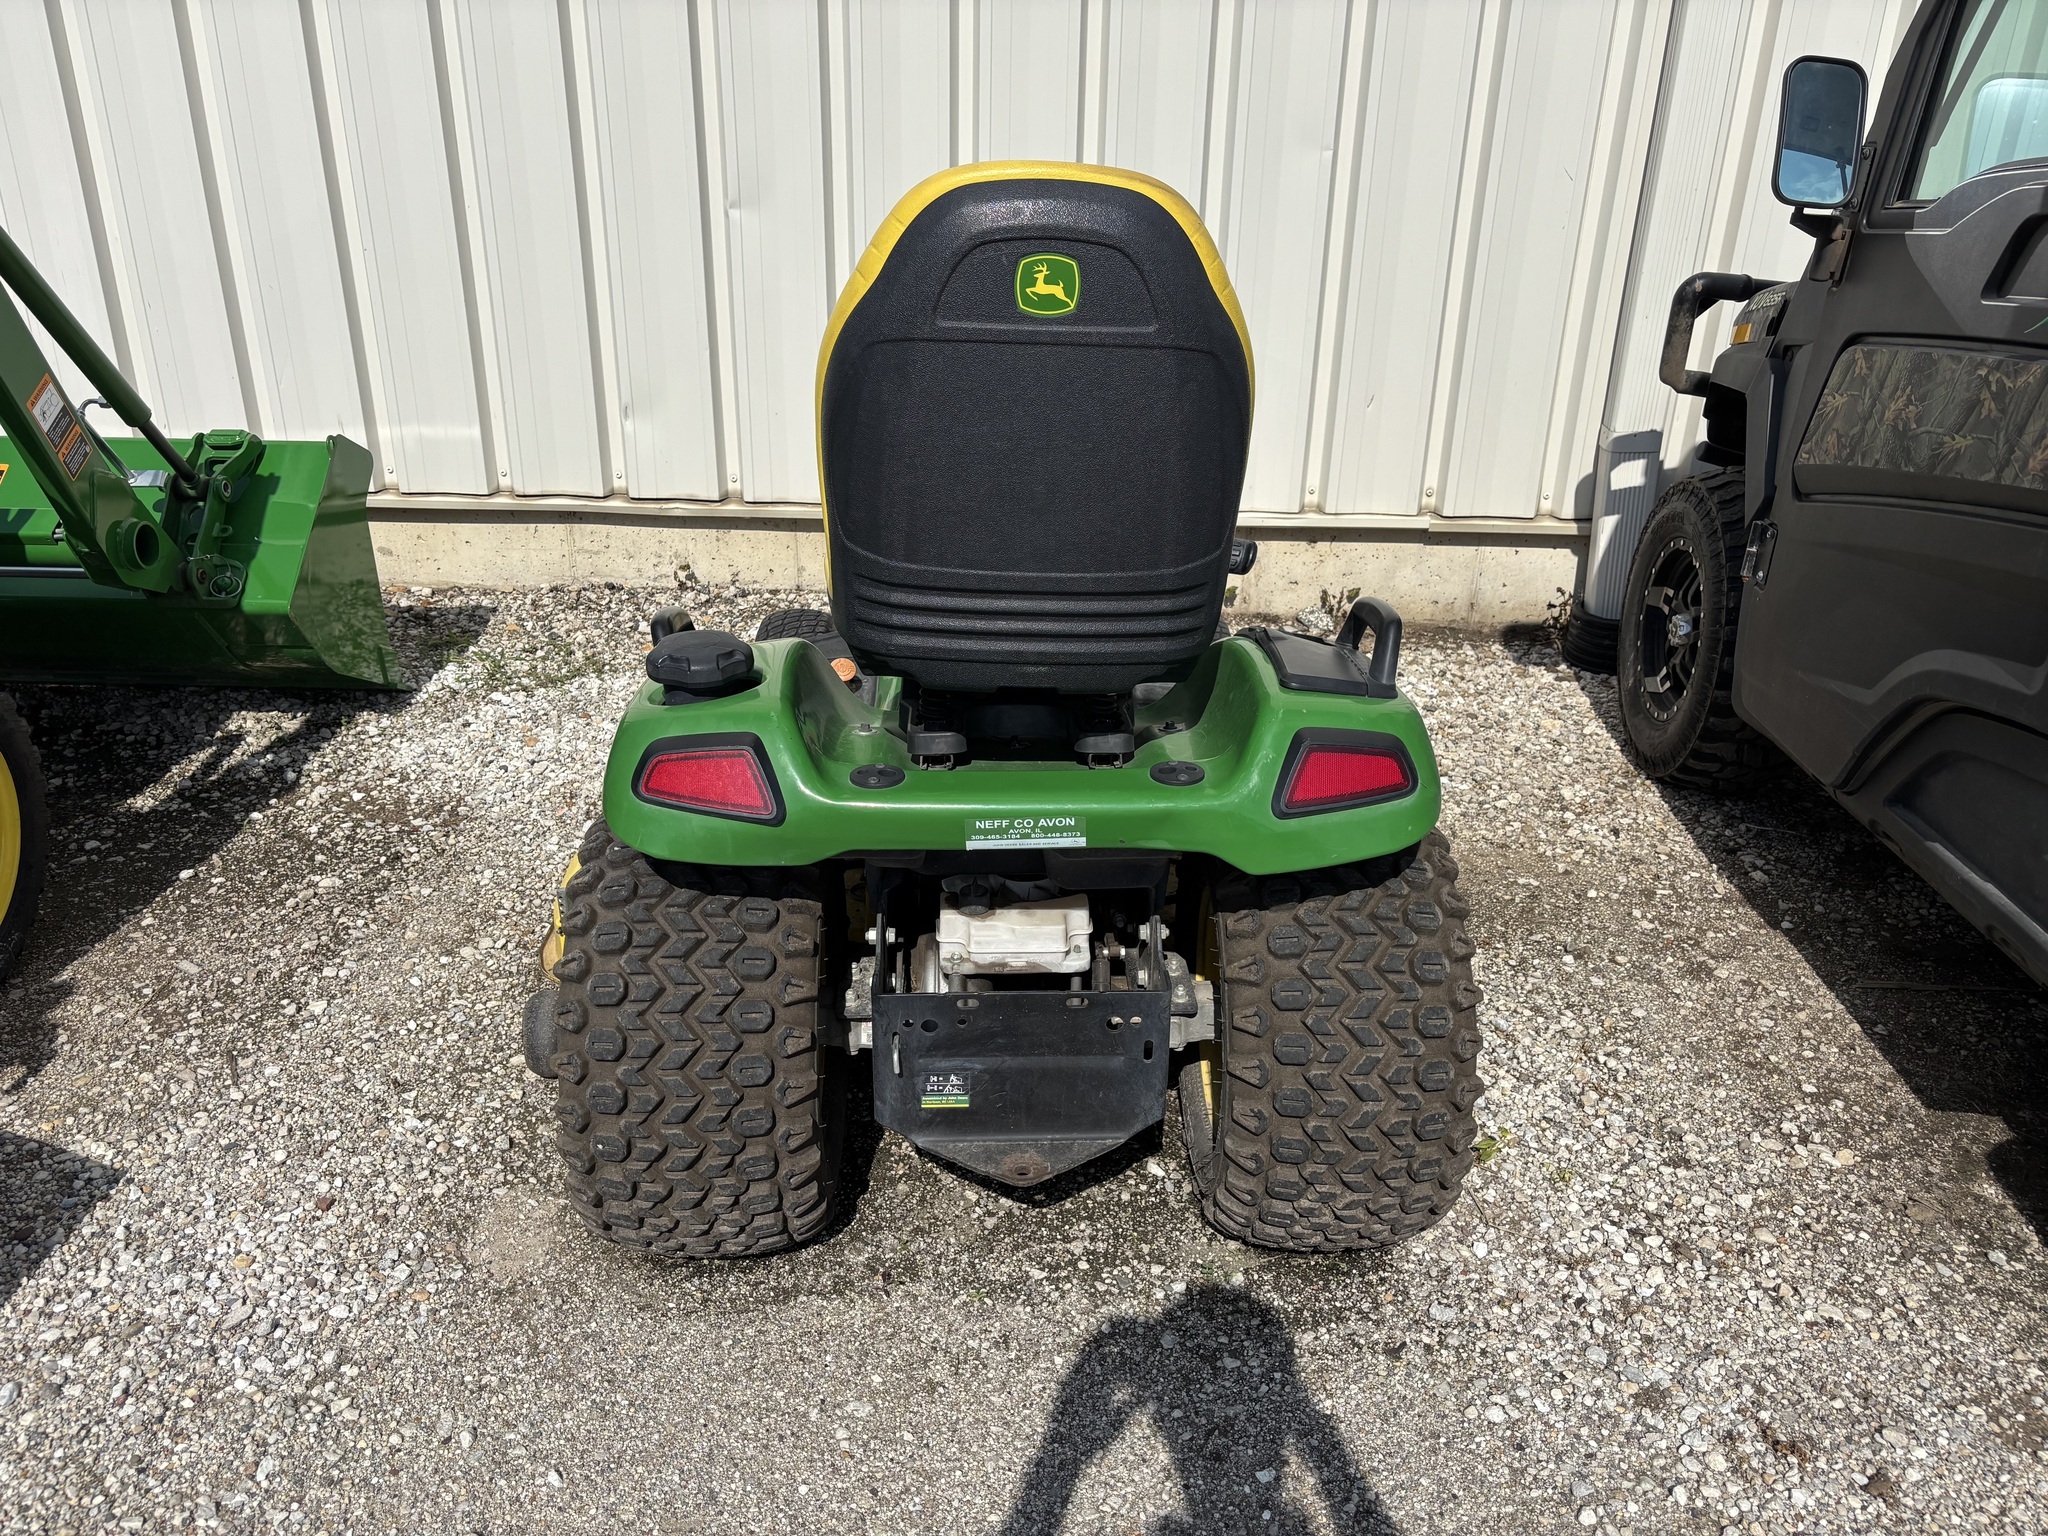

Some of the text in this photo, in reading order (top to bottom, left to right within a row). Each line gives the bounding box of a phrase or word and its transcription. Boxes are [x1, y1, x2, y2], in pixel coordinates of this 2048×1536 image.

[975, 817, 1075, 829] NEFF CO AVON
